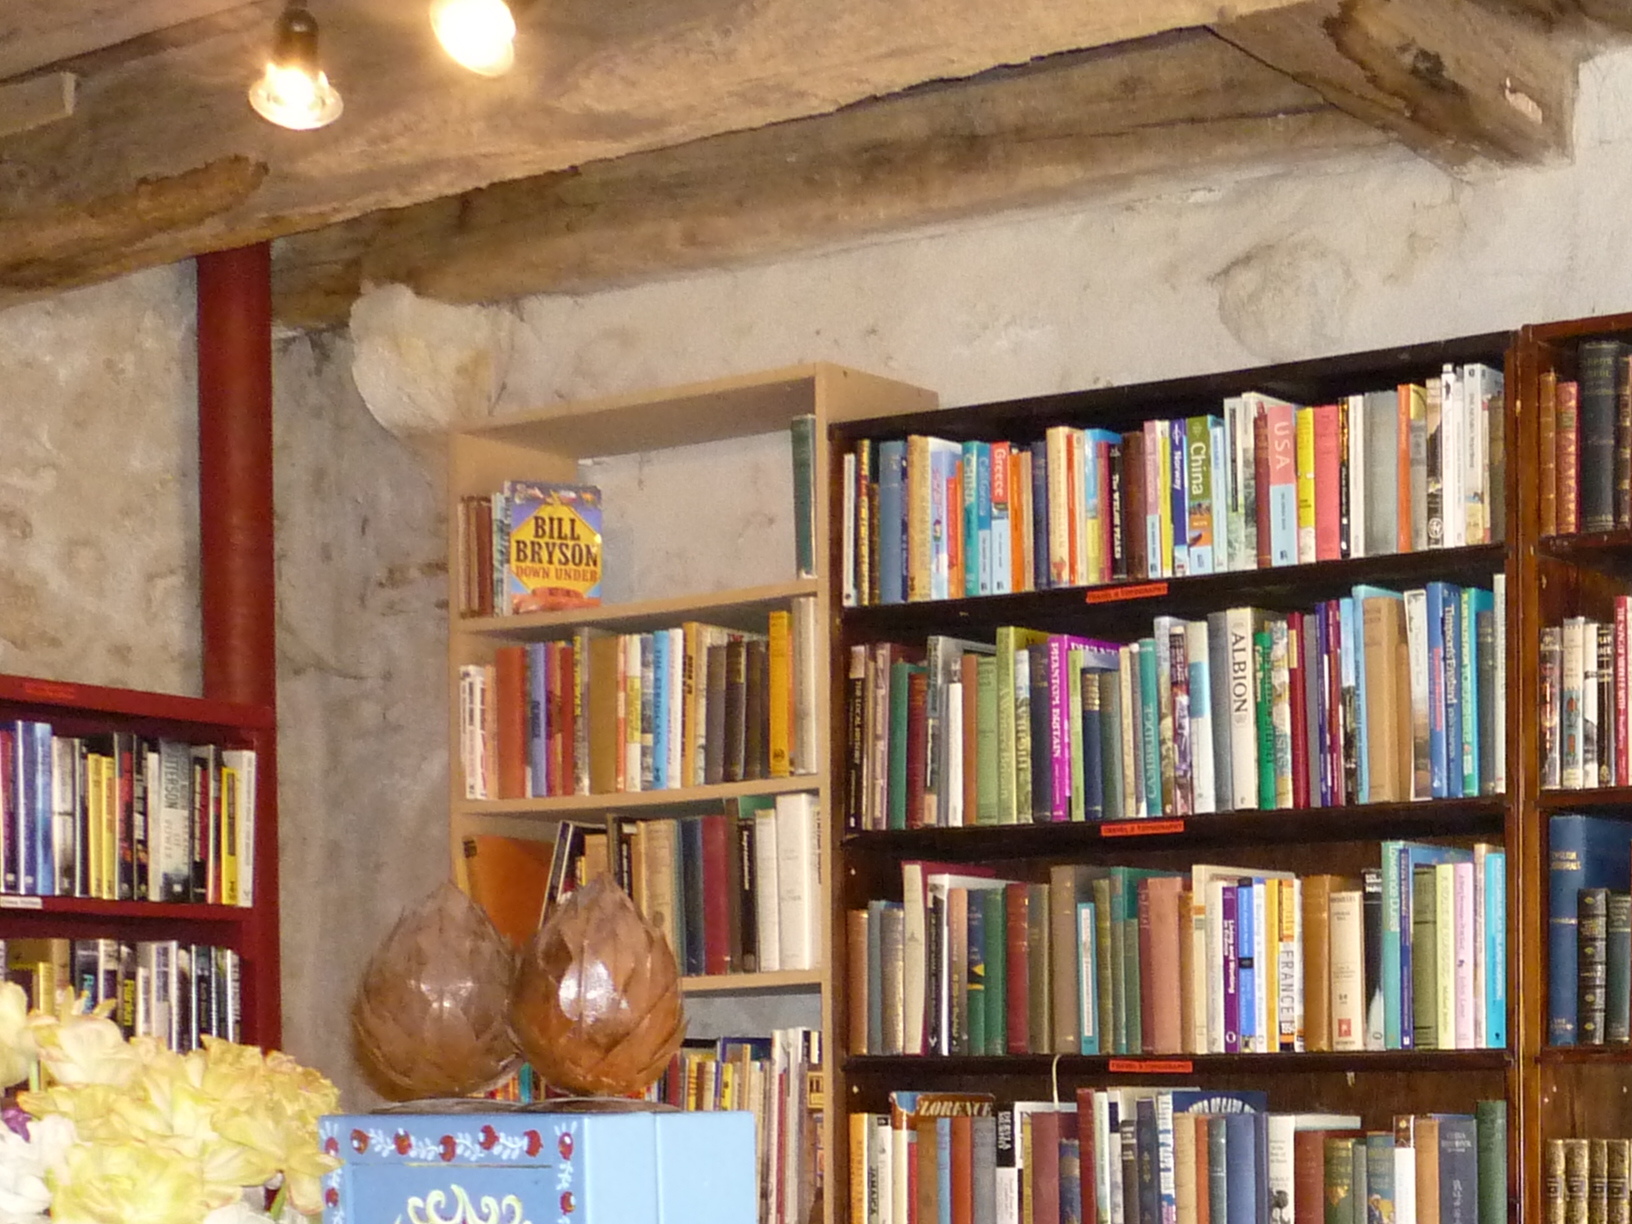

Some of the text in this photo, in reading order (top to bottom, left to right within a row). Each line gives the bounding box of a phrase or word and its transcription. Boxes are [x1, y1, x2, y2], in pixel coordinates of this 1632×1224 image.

[1172, 450, 1183, 490] Norway
[1190, 442, 1207, 495] China
[1273, 421, 1292, 470] USA
[978, 456, 990, 516] California
[993, 448, 1006, 498] Greece
[514, 539, 599, 568] BRYSON
[533, 515, 581, 542] BILL
[515, 566, 598, 583] DOWN UNDER
[1231, 632, 1249, 714] ALBION
[1049, 641, 1062, 758] PHANTOM BRITAIN
[1143, 704, 1157, 799] CAMBRIDGE
[1279, 950, 1296, 1015] FRANCE
[869, 1165, 878, 1215] JAMAICA
